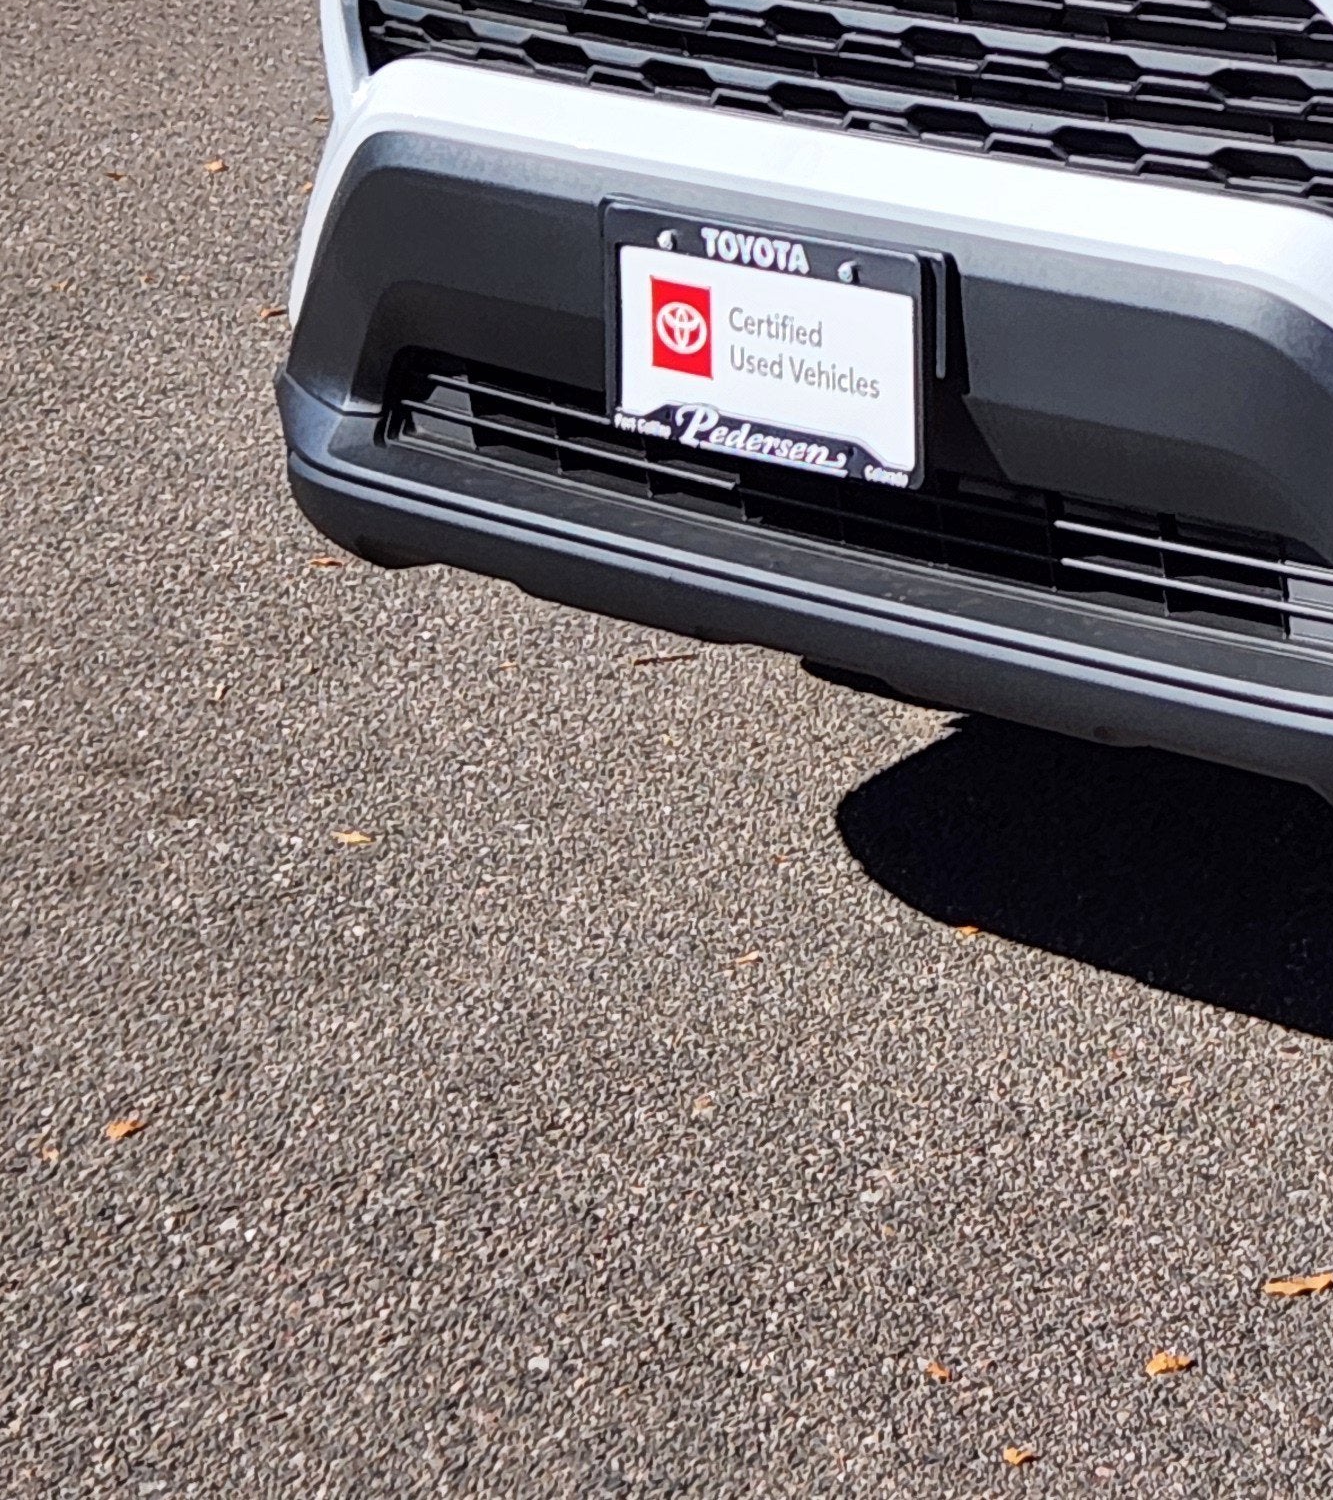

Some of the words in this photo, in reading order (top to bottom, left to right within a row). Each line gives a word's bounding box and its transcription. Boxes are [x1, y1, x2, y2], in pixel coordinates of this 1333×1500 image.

[701, 226, 811, 275] TOYOTA
[728, 306, 823, 348] Certified
[730, 344, 783, 380] Used
[789, 355, 880, 399] Vehicles
[675, 404, 848, 468] Pedersen
